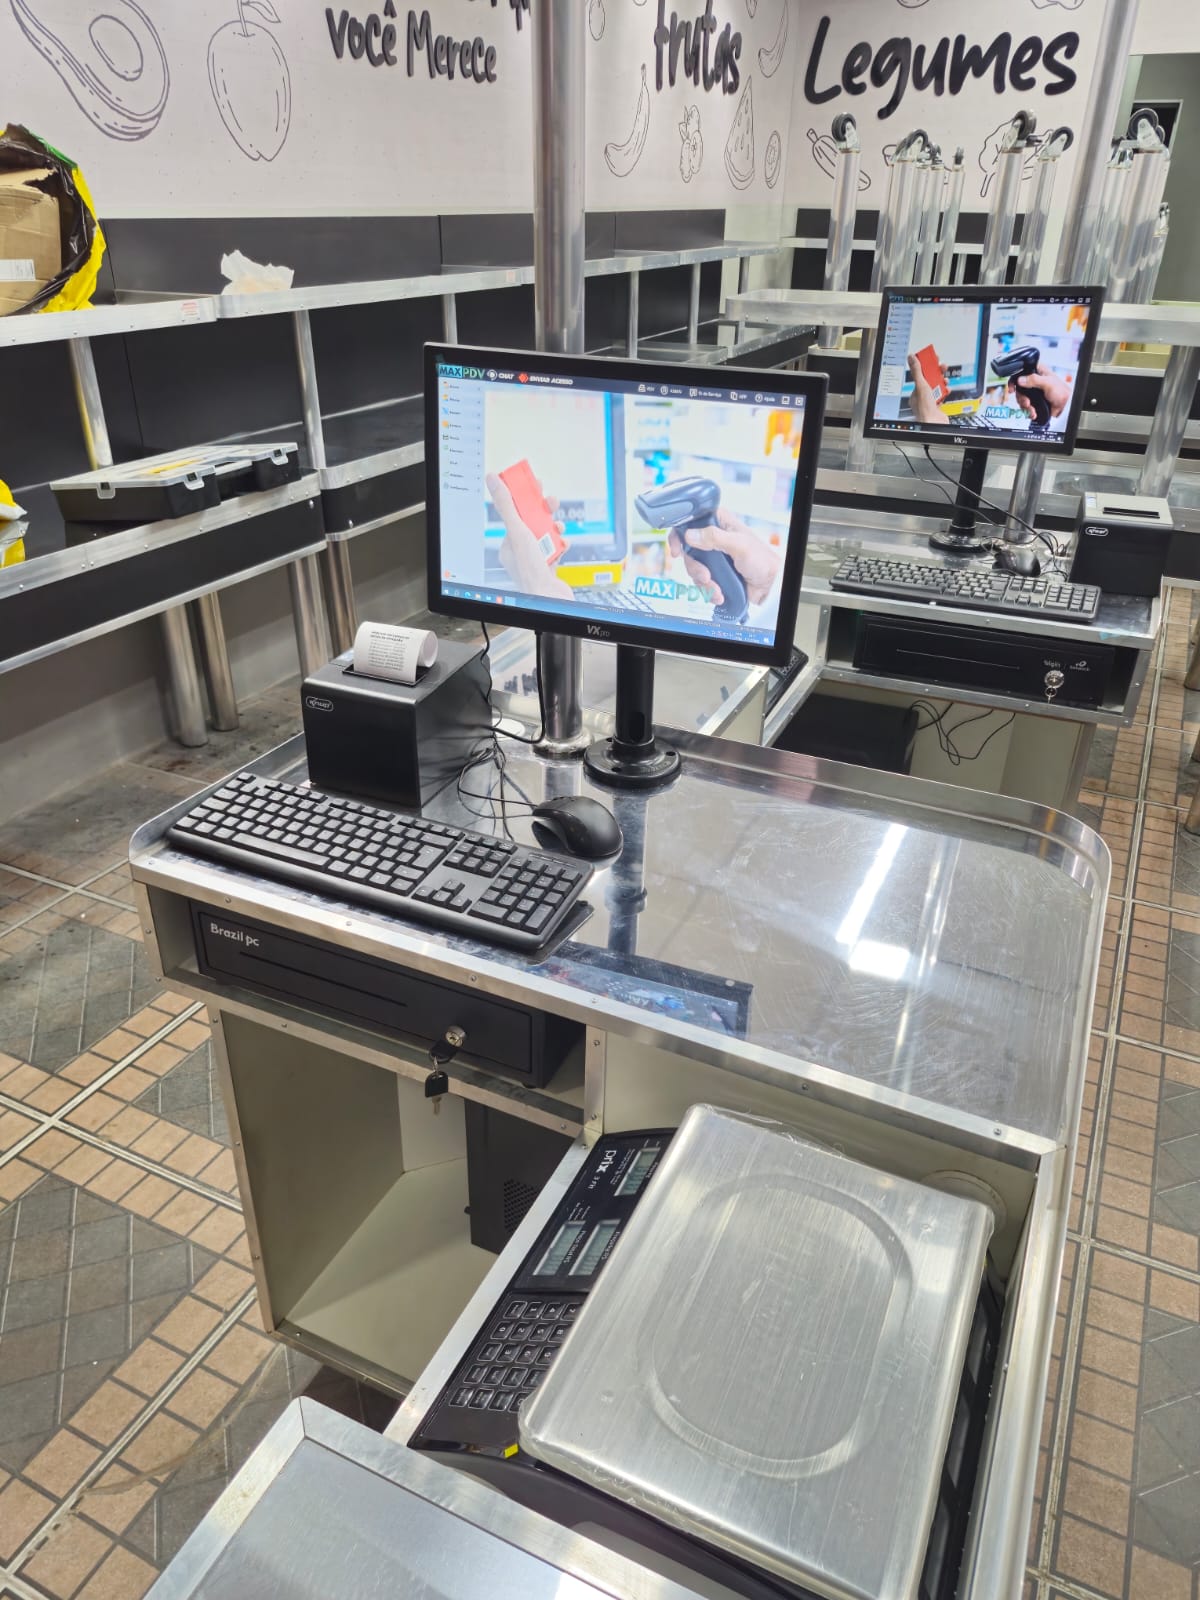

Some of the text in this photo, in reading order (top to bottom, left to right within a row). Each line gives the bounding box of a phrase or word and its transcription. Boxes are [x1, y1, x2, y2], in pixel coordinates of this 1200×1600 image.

[405, 9, 498, 84] Merece
[804, 16, 1080, 120] Legumes
[210, 922, 260, 947] Brazil pc
[595, 1150, 617, 1173] prix
